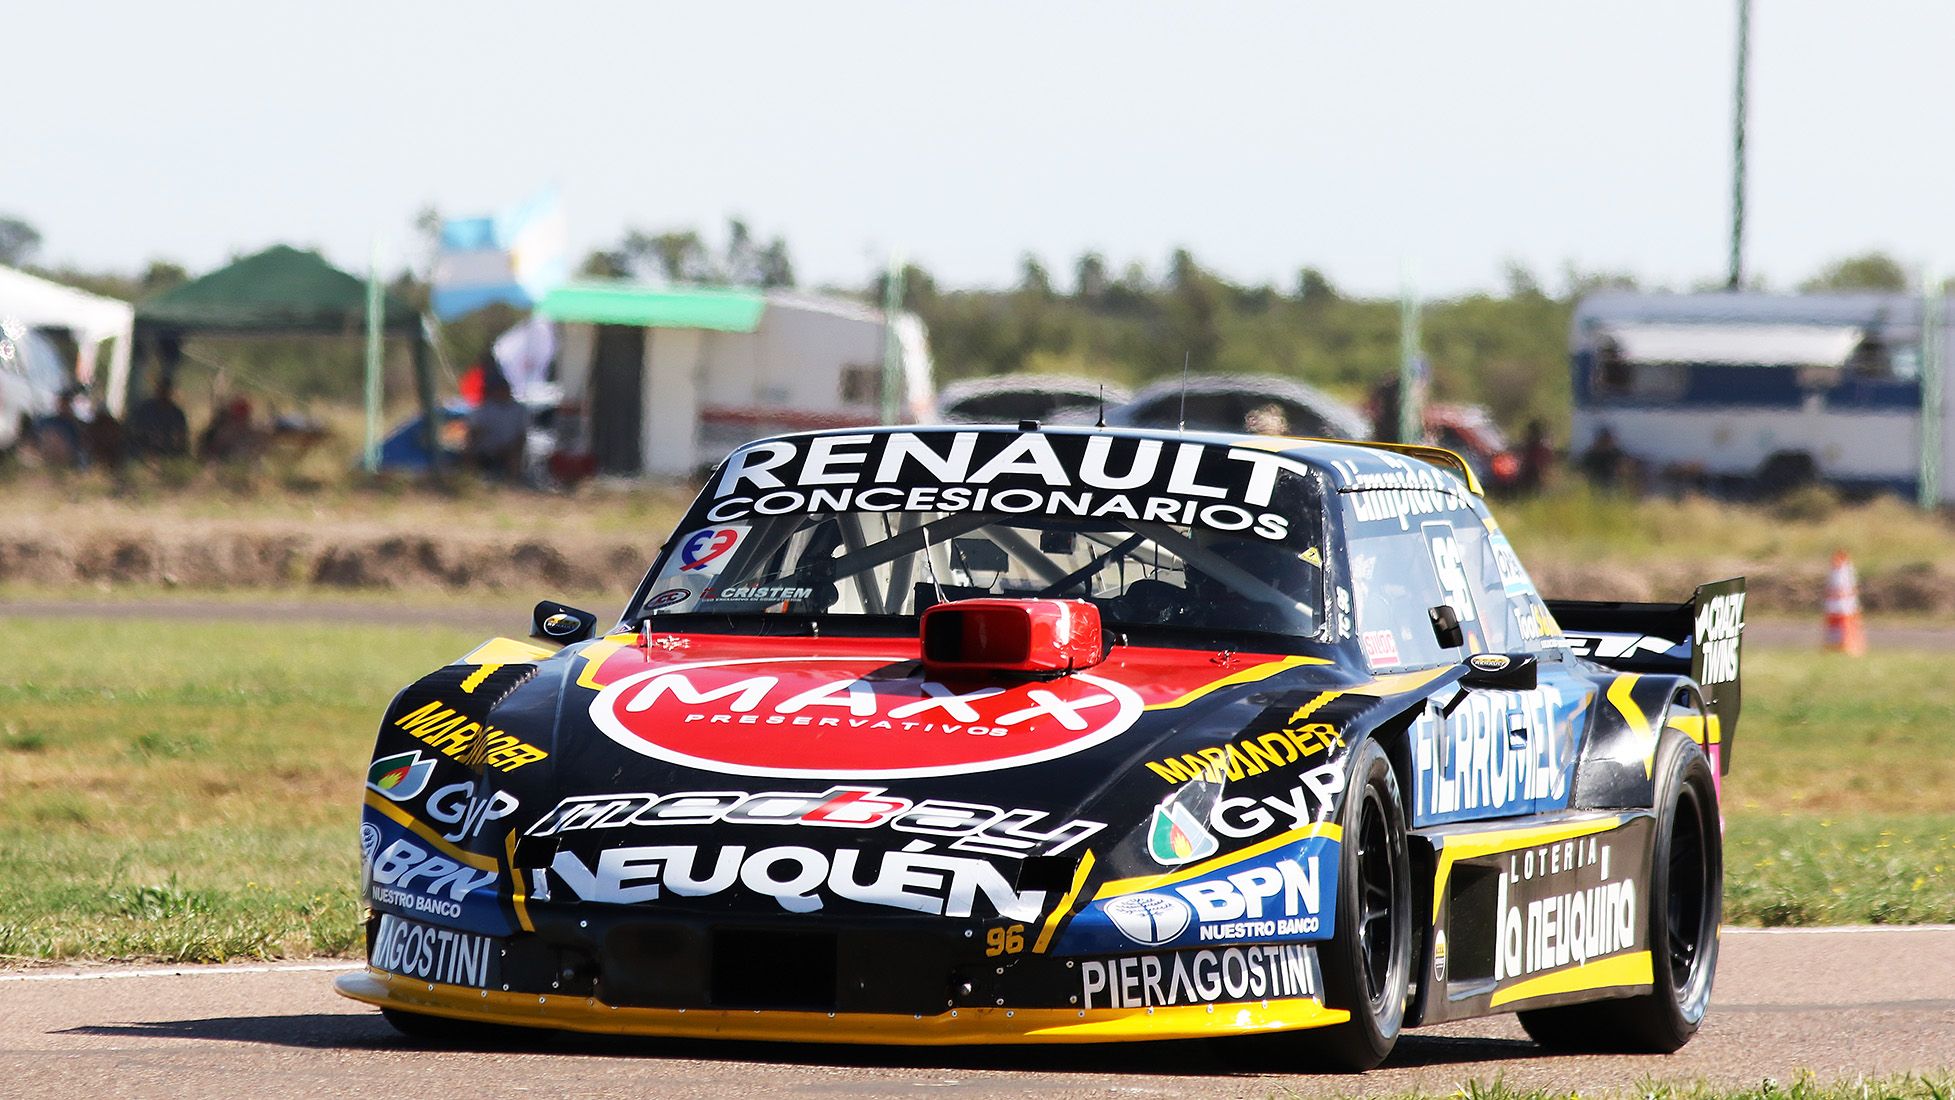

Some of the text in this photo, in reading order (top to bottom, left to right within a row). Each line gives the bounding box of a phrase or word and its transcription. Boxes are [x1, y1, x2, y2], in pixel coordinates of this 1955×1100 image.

[715, 432, 1308, 507] RENAULT
[706, 486, 1290, 542] CONCESIONARIOS
[1707, 592, 1746, 644] CRAZY
[1701, 637, 1739, 686] TWINS
[625, 674, 1117, 731] MAXX
[684, 713, 1008, 737] PRESERVATIVOS
[1145, 722, 1346, 785] MARANDER
[1209, 762, 1347, 838] GyP
[373, 838, 499, 902] BPN
[529, 838, 1046, 924] NEUQUÉN
[1510, 836, 1597, 884] LOTERIA
[372, 885, 461, 919] NUESTRO BANCO
[1176, 856, 1320, 923] BPN
[985, 924, 1025, 957] 96
[1200, 916, 1319, 942] NUESTRO BANCO
[1081, 944, 1317, 1010] PIERAGOSTINI
